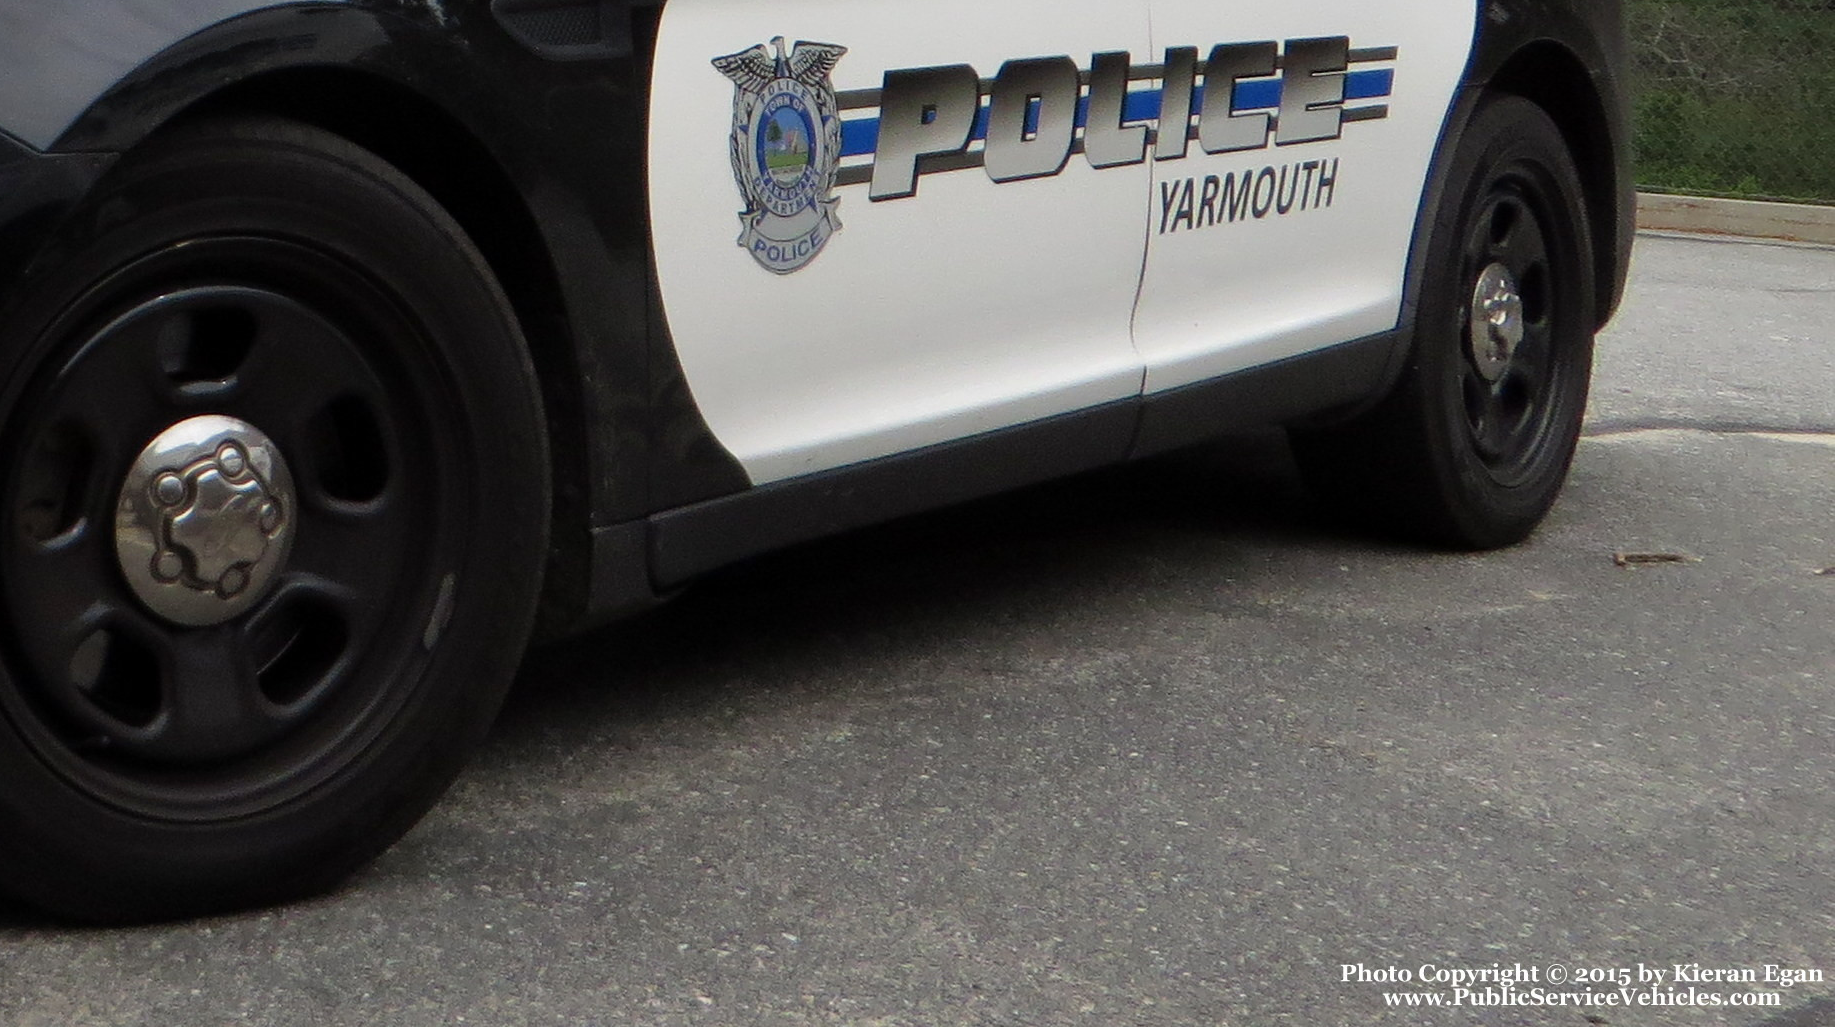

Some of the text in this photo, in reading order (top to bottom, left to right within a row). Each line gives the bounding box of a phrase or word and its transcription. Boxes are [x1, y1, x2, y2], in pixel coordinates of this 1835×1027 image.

[760, 80, 808, 105] POLICE
[766, 97, 806, 118] TOWN OF
[867, 34, 1350, 203] POLICE
[1158, 157, 1339, 235] YARMOUTH
[754, 228, 823, 263] POLICE
